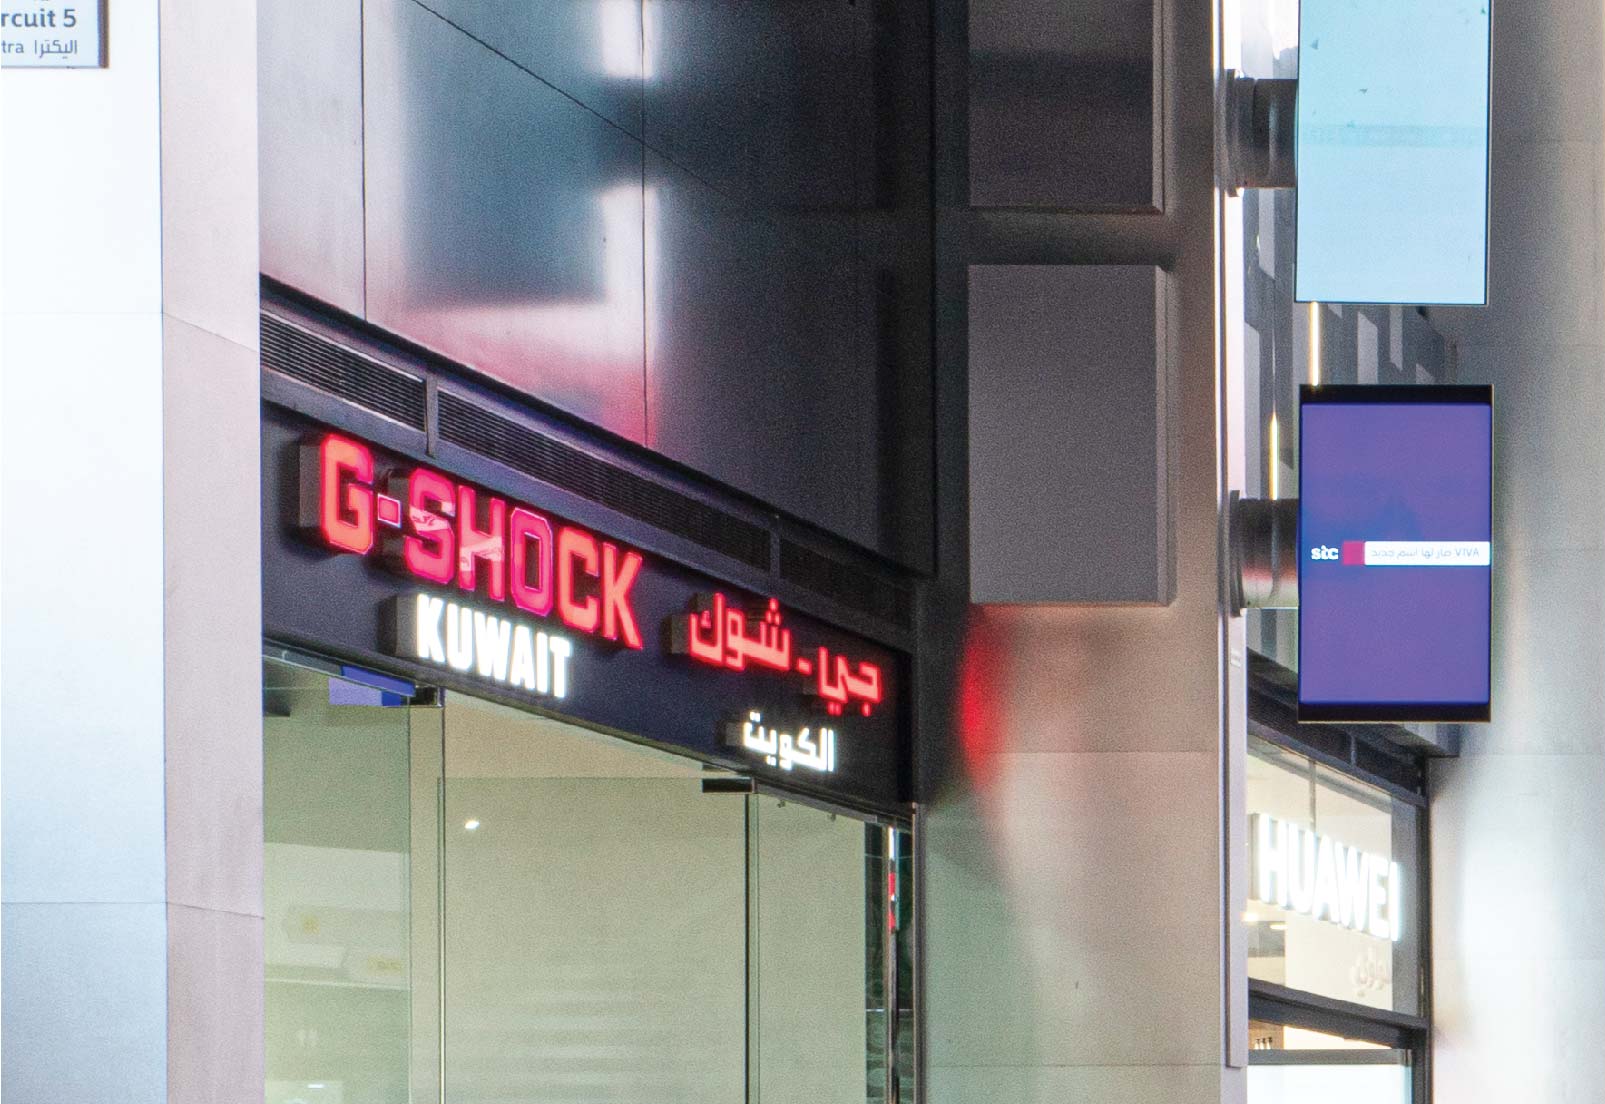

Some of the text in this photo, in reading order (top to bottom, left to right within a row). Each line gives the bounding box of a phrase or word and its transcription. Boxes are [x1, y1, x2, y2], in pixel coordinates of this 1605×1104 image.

[63, 8, 77, 27] 5
[321, 434, 643, 650] G-SHOCK
[1311, 545, 1339, 560] stc
[416, 592, 574, 698] KUWAIT
[743, 711, 837, 772] الكويت
[1257, 812, 1402, 942] HUAWEI
